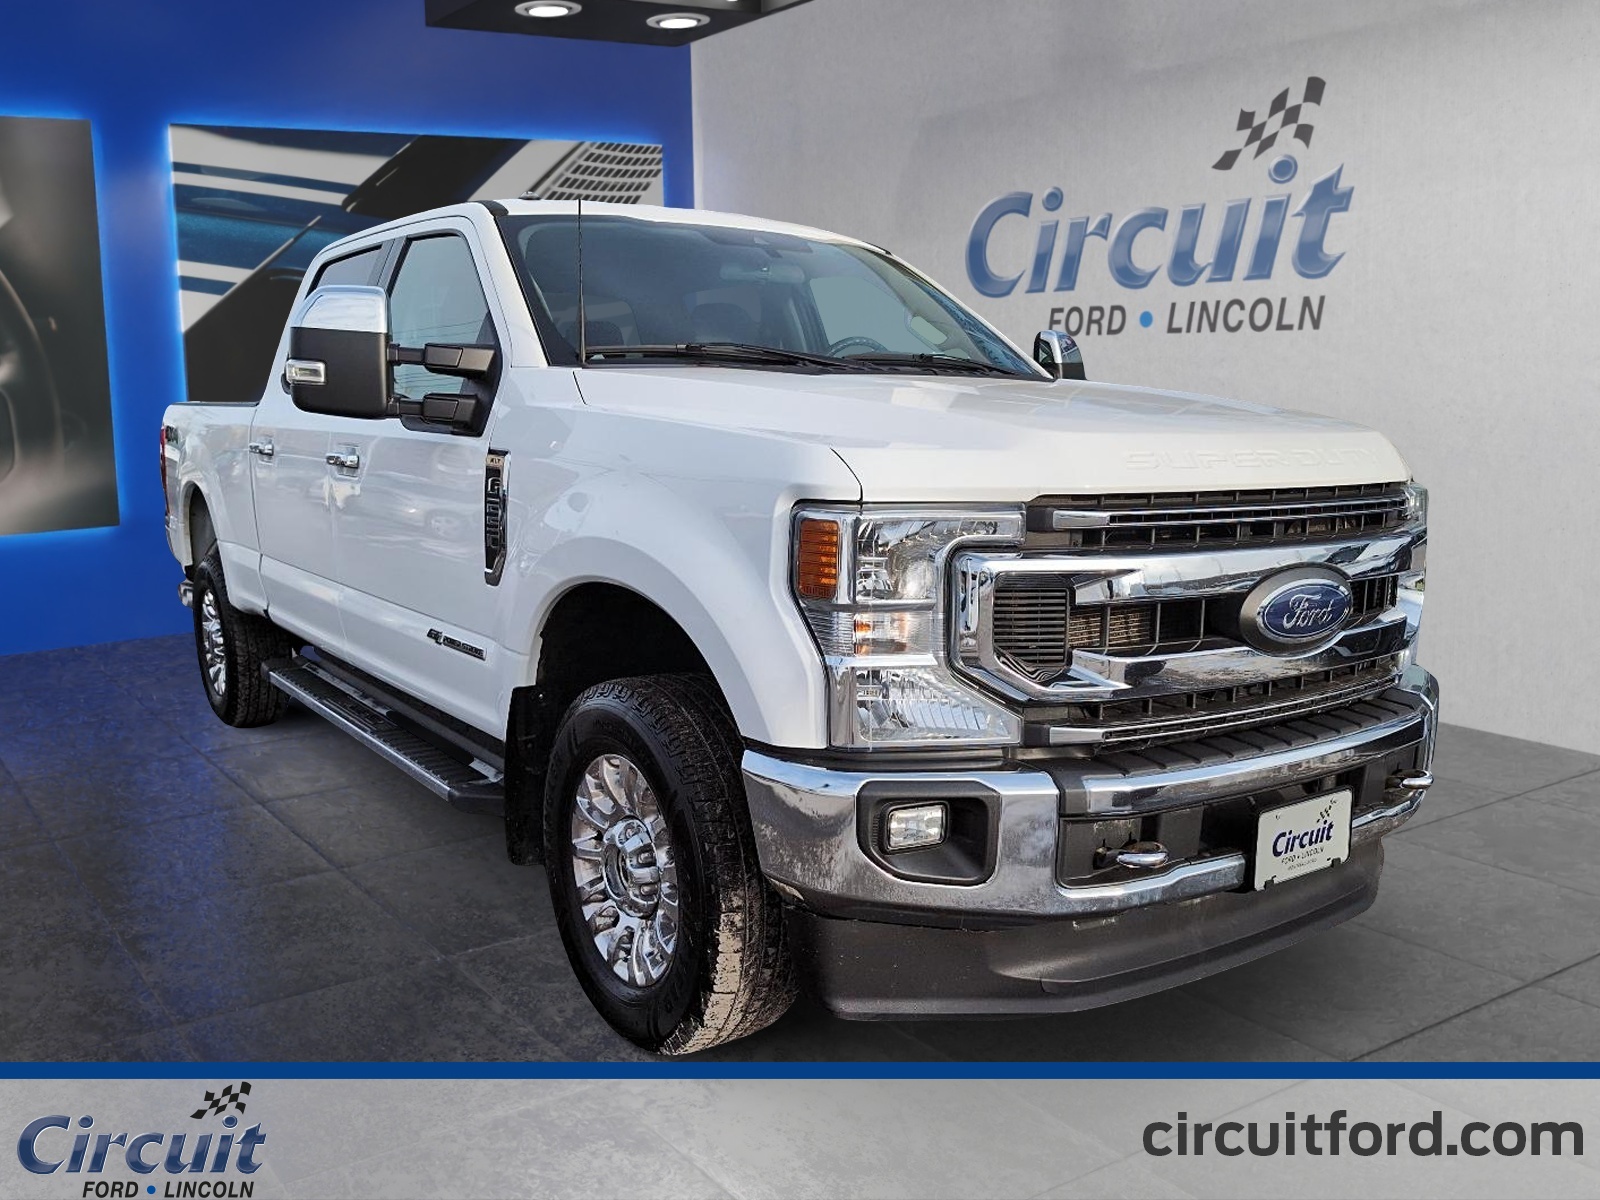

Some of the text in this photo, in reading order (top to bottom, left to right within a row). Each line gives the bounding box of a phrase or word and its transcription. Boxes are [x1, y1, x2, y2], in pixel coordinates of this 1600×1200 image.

[965, 154, 1355, 298] Circuit
[1048, 296, 1325, 336] FORD LINCOLN
[1126, 448, 1290, 470] SUPER
[1283, 594, 1333, 629] Ford
[1272, 820, 1334, 857] Circuit
